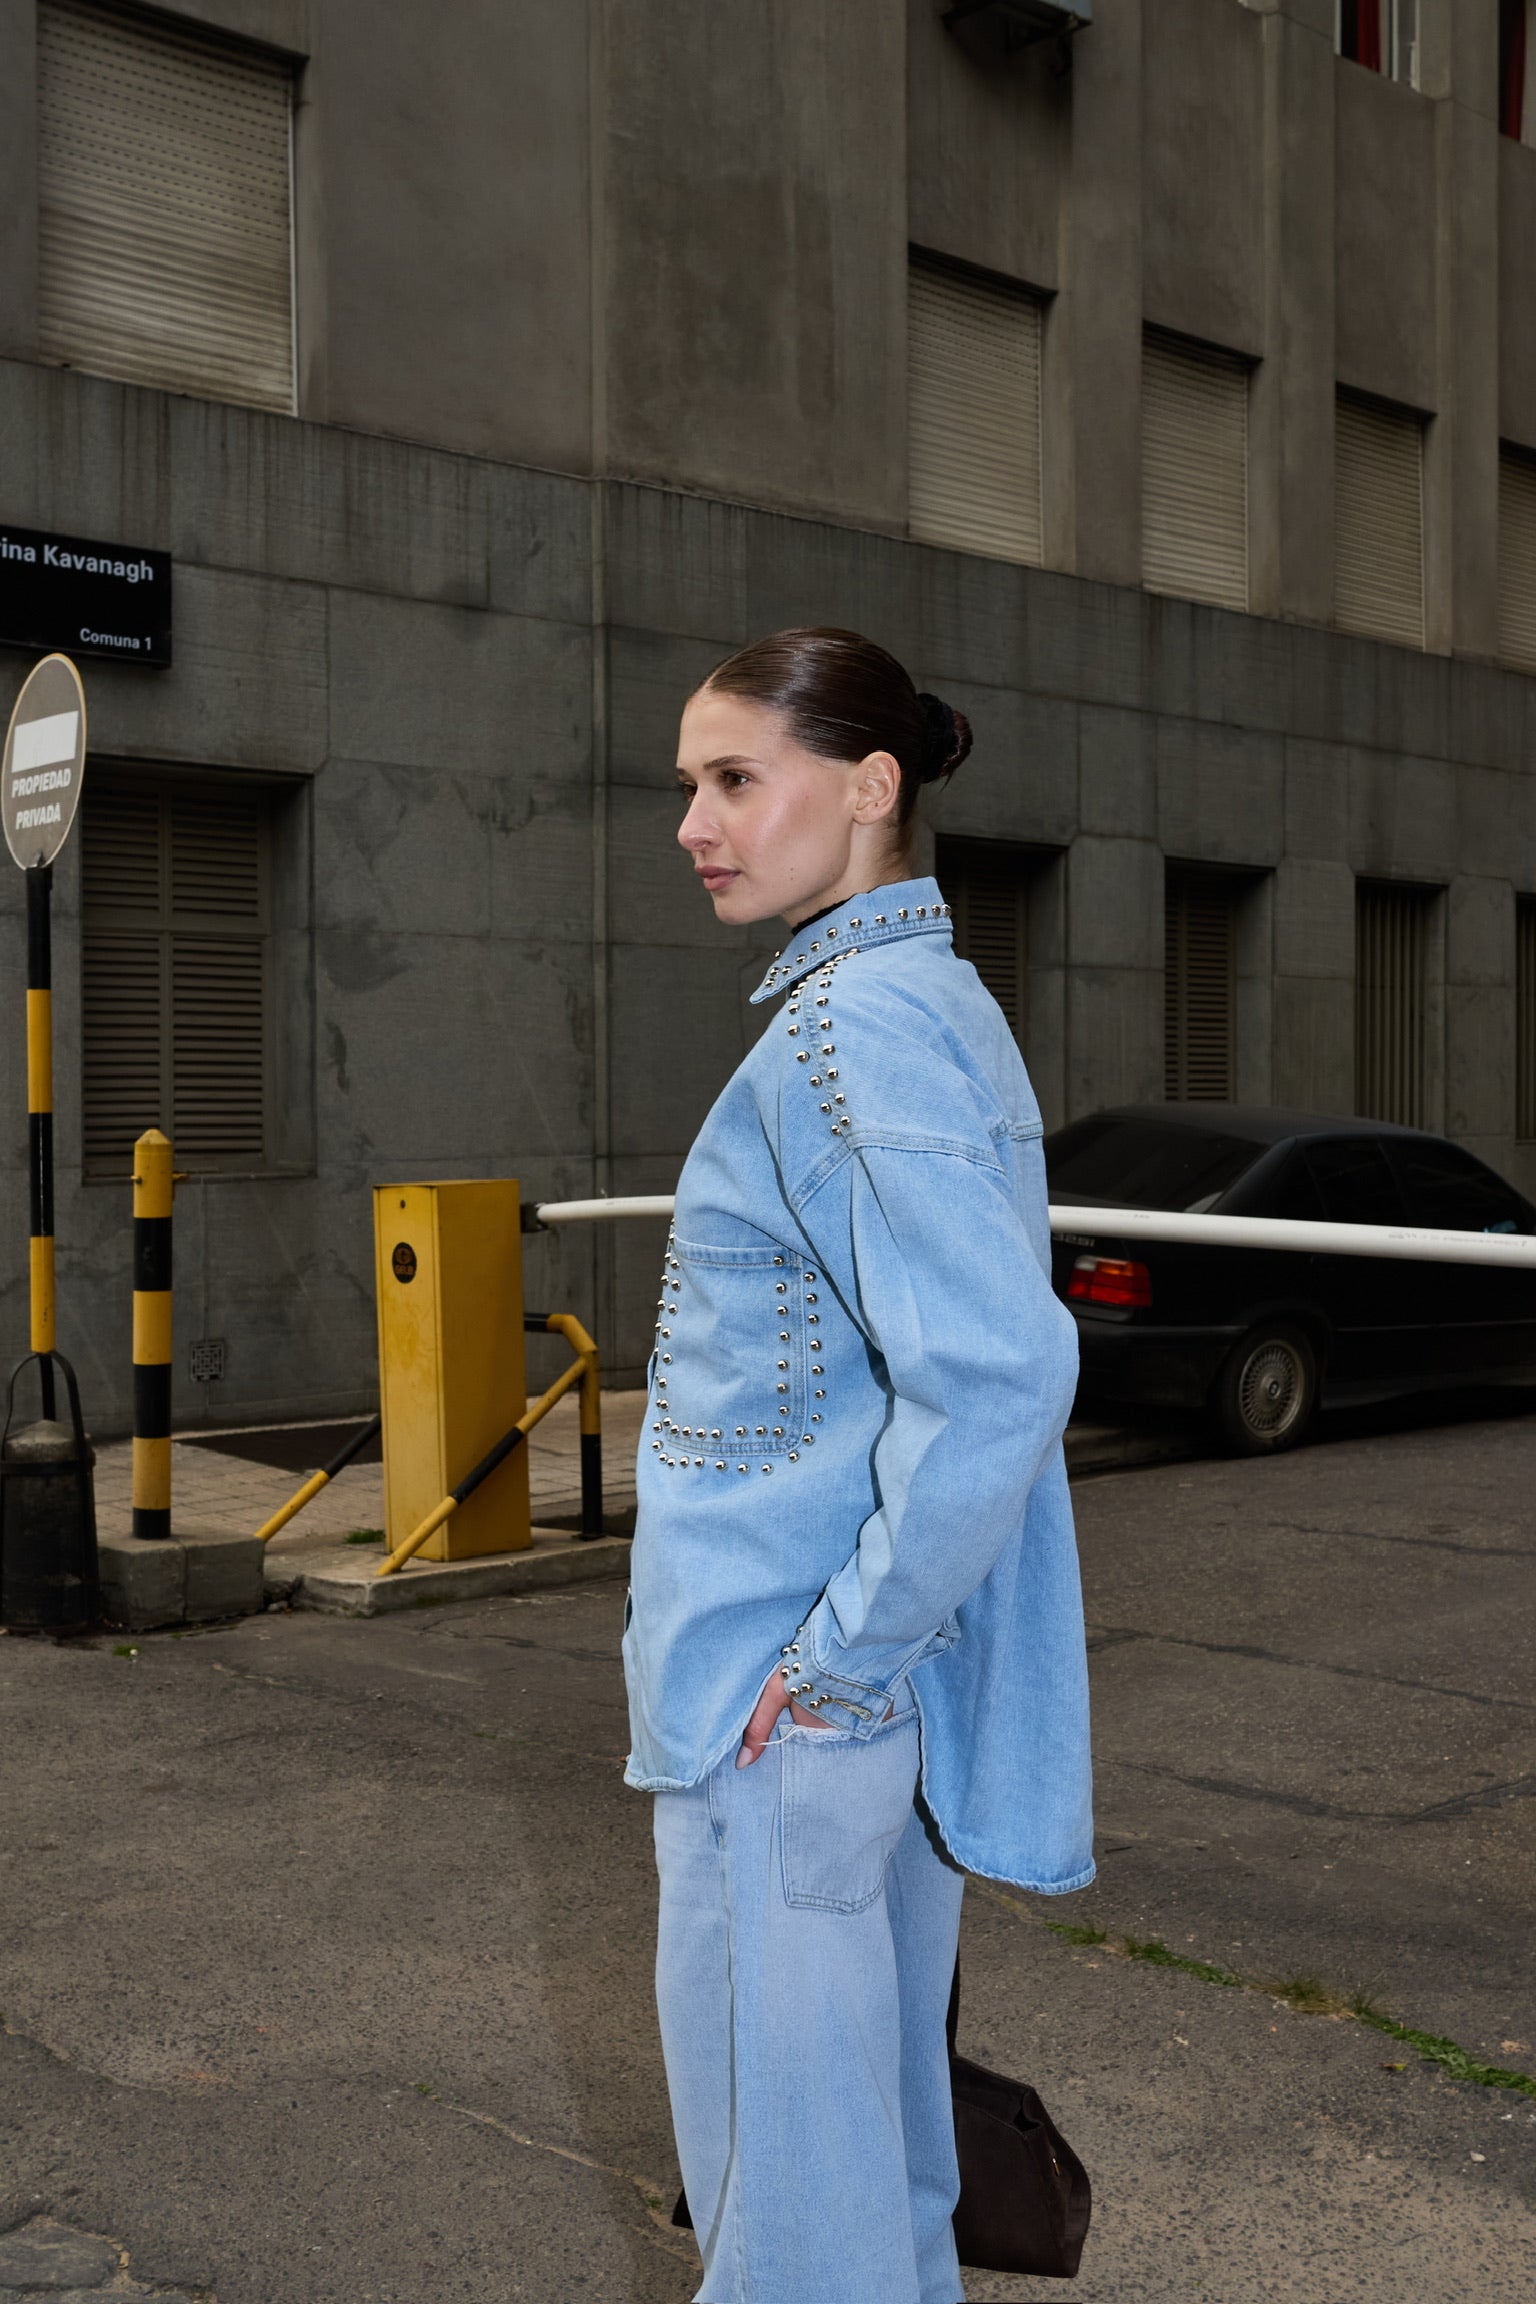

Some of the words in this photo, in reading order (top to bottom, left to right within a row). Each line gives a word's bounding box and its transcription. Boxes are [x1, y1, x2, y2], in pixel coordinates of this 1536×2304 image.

[0, 537, 36, 563] ina
[43, 544, 154, 583] Kavanagh
[80, 628, 140, 649] Comuna
[144, 637, 152, 650] 1
[12, 768, 71, 798] PROPIEDAD
[16, 802, 61, 830] PRIVADA
